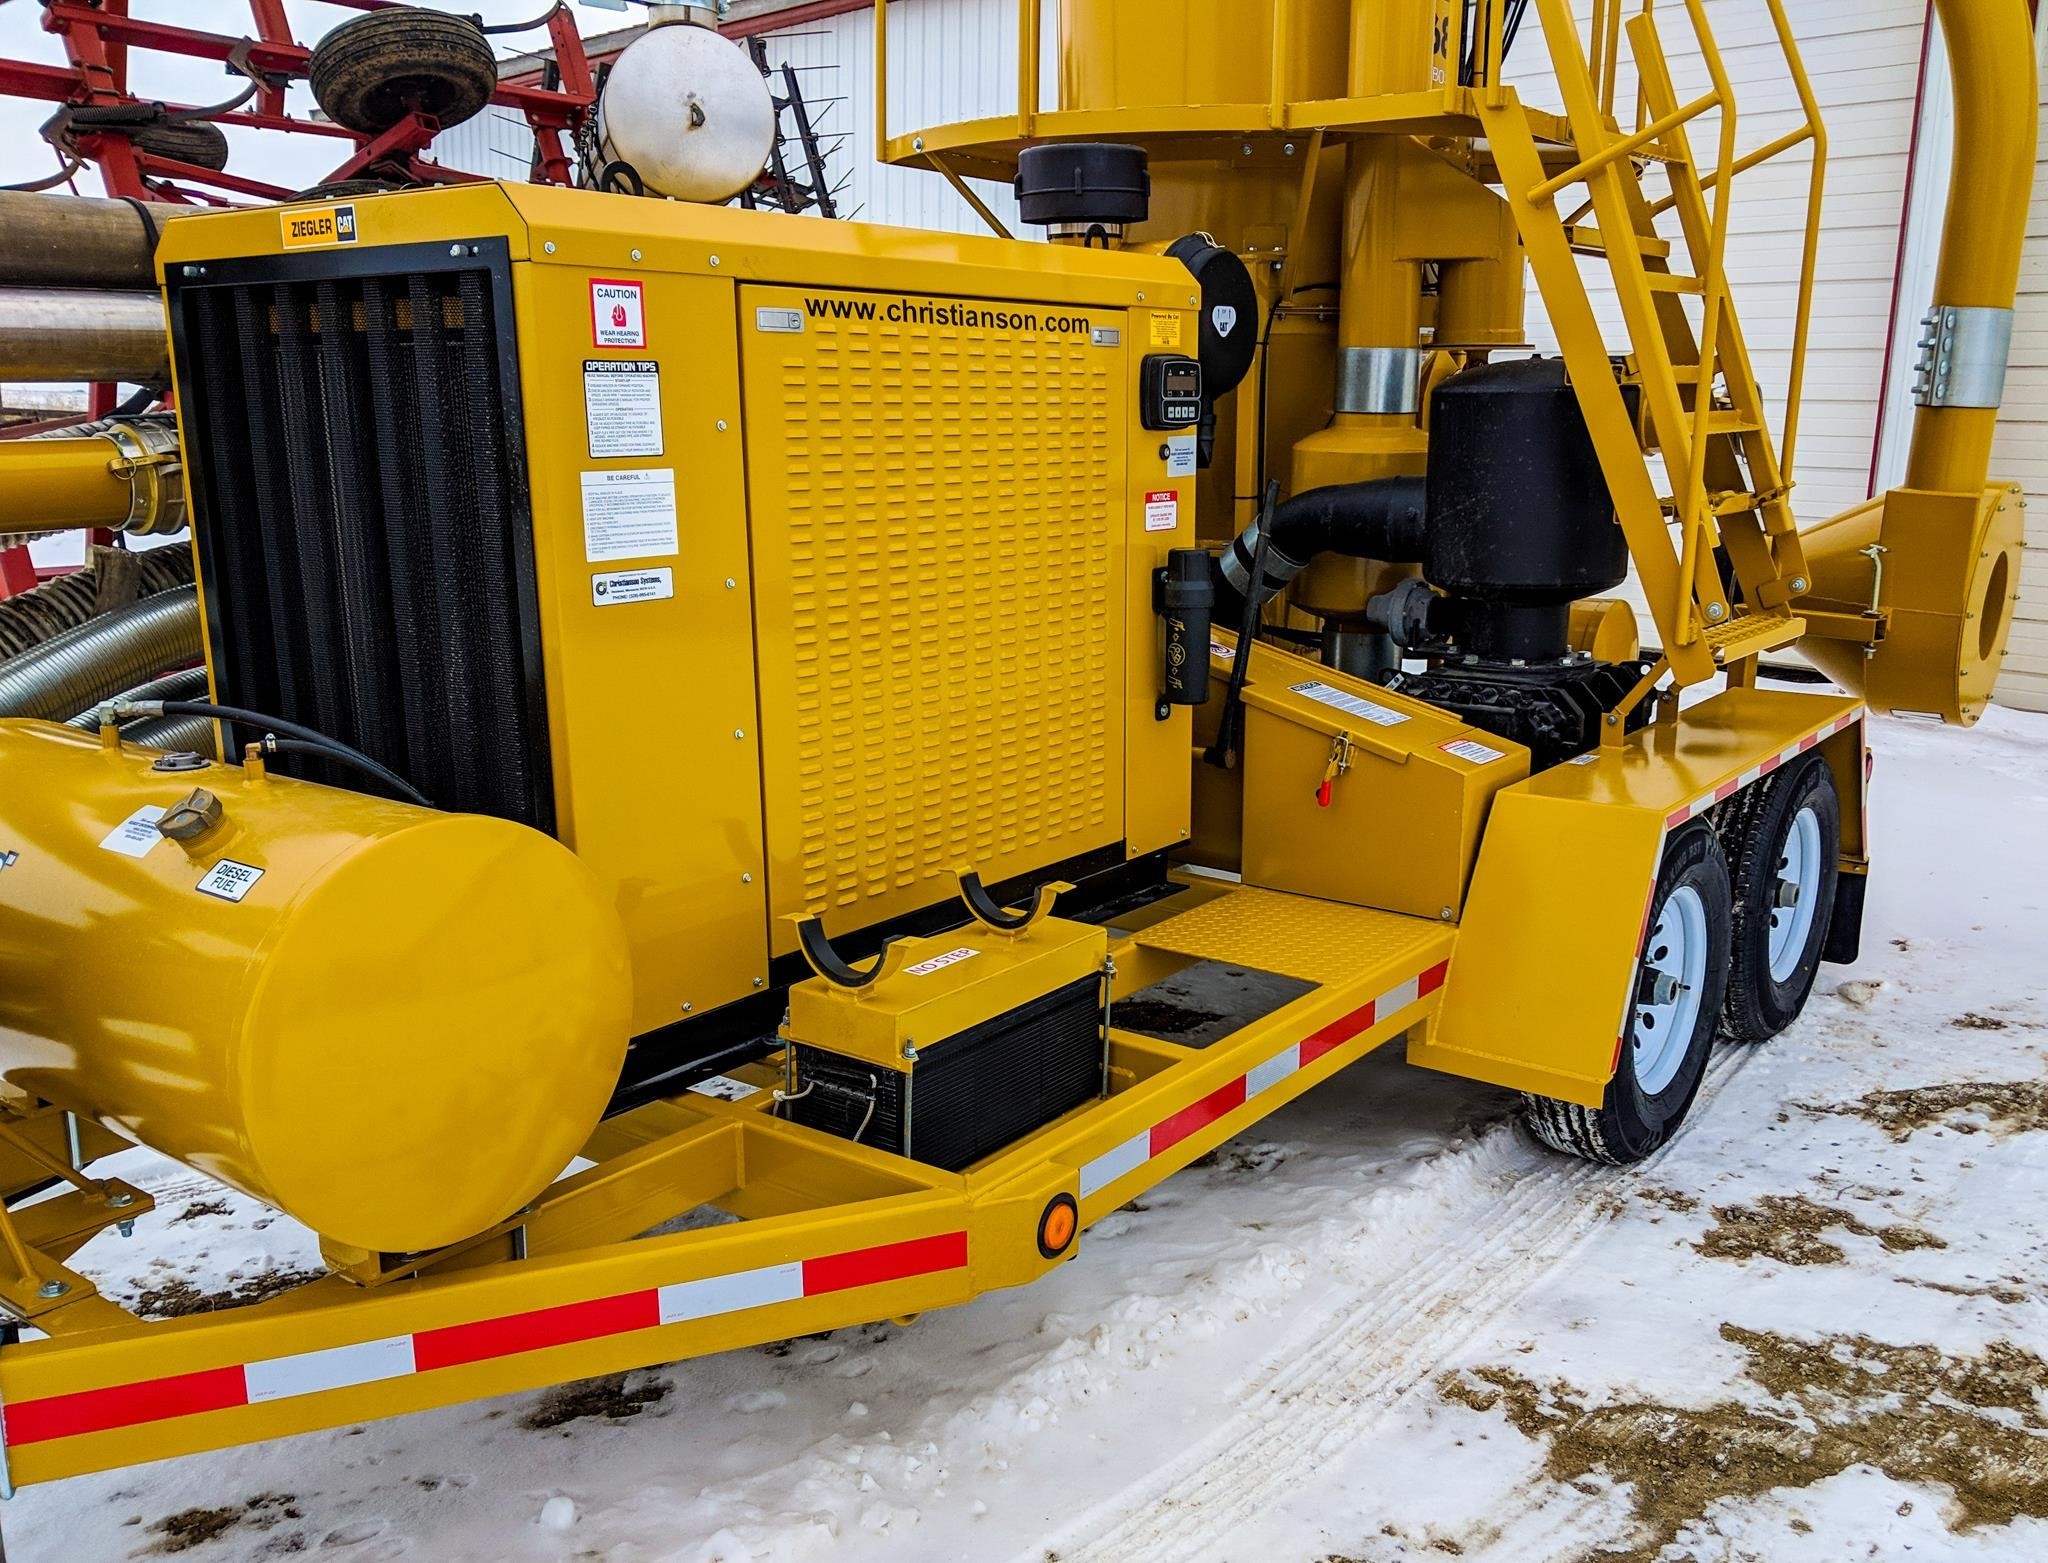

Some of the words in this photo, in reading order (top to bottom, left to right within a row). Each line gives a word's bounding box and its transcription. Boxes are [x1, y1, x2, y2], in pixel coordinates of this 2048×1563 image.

[290, 218, 333, 238] ZIEGLER
[337, 215, 353, 233] CAT
[596, 287, 637, 300] CAUTION
[804, 297, 1090, 334] www.christianson.com
[585, 361, 636, 372] OPERATION
[638, 362, 657, 372] TIPS
[606, 474, 615, 482] BE
[1151, 492, 1171, 502] NOTICE
[609, 578, 640, 588] Christianson
[216, 864, 253, 882] DIESEL
[210, 876, 238, 893] FUEL
[908, 962, 937, 974] NO
[935, 949, 971, 965] STEP
